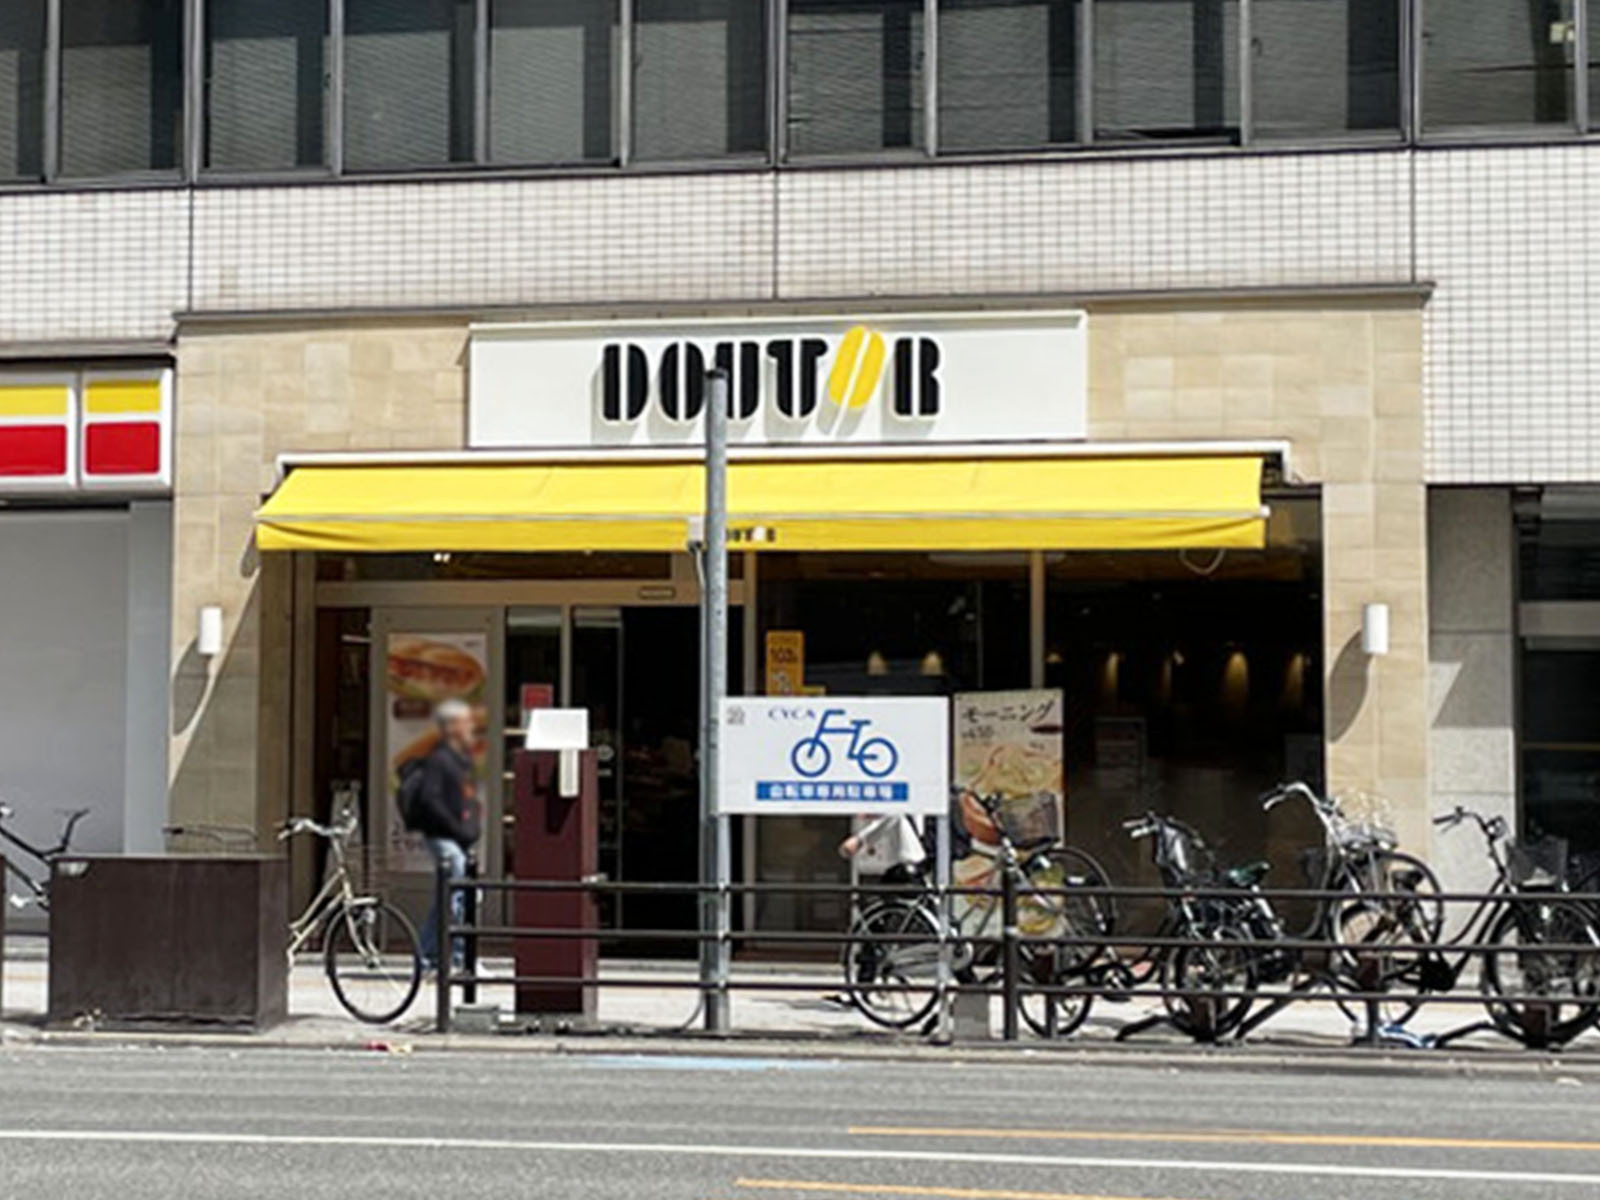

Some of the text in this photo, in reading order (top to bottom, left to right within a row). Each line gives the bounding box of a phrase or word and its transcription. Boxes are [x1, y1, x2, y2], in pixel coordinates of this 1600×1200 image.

[602, 326, 940, 421] DOUTOR
[961, 699, 1055, 723] モーニング
